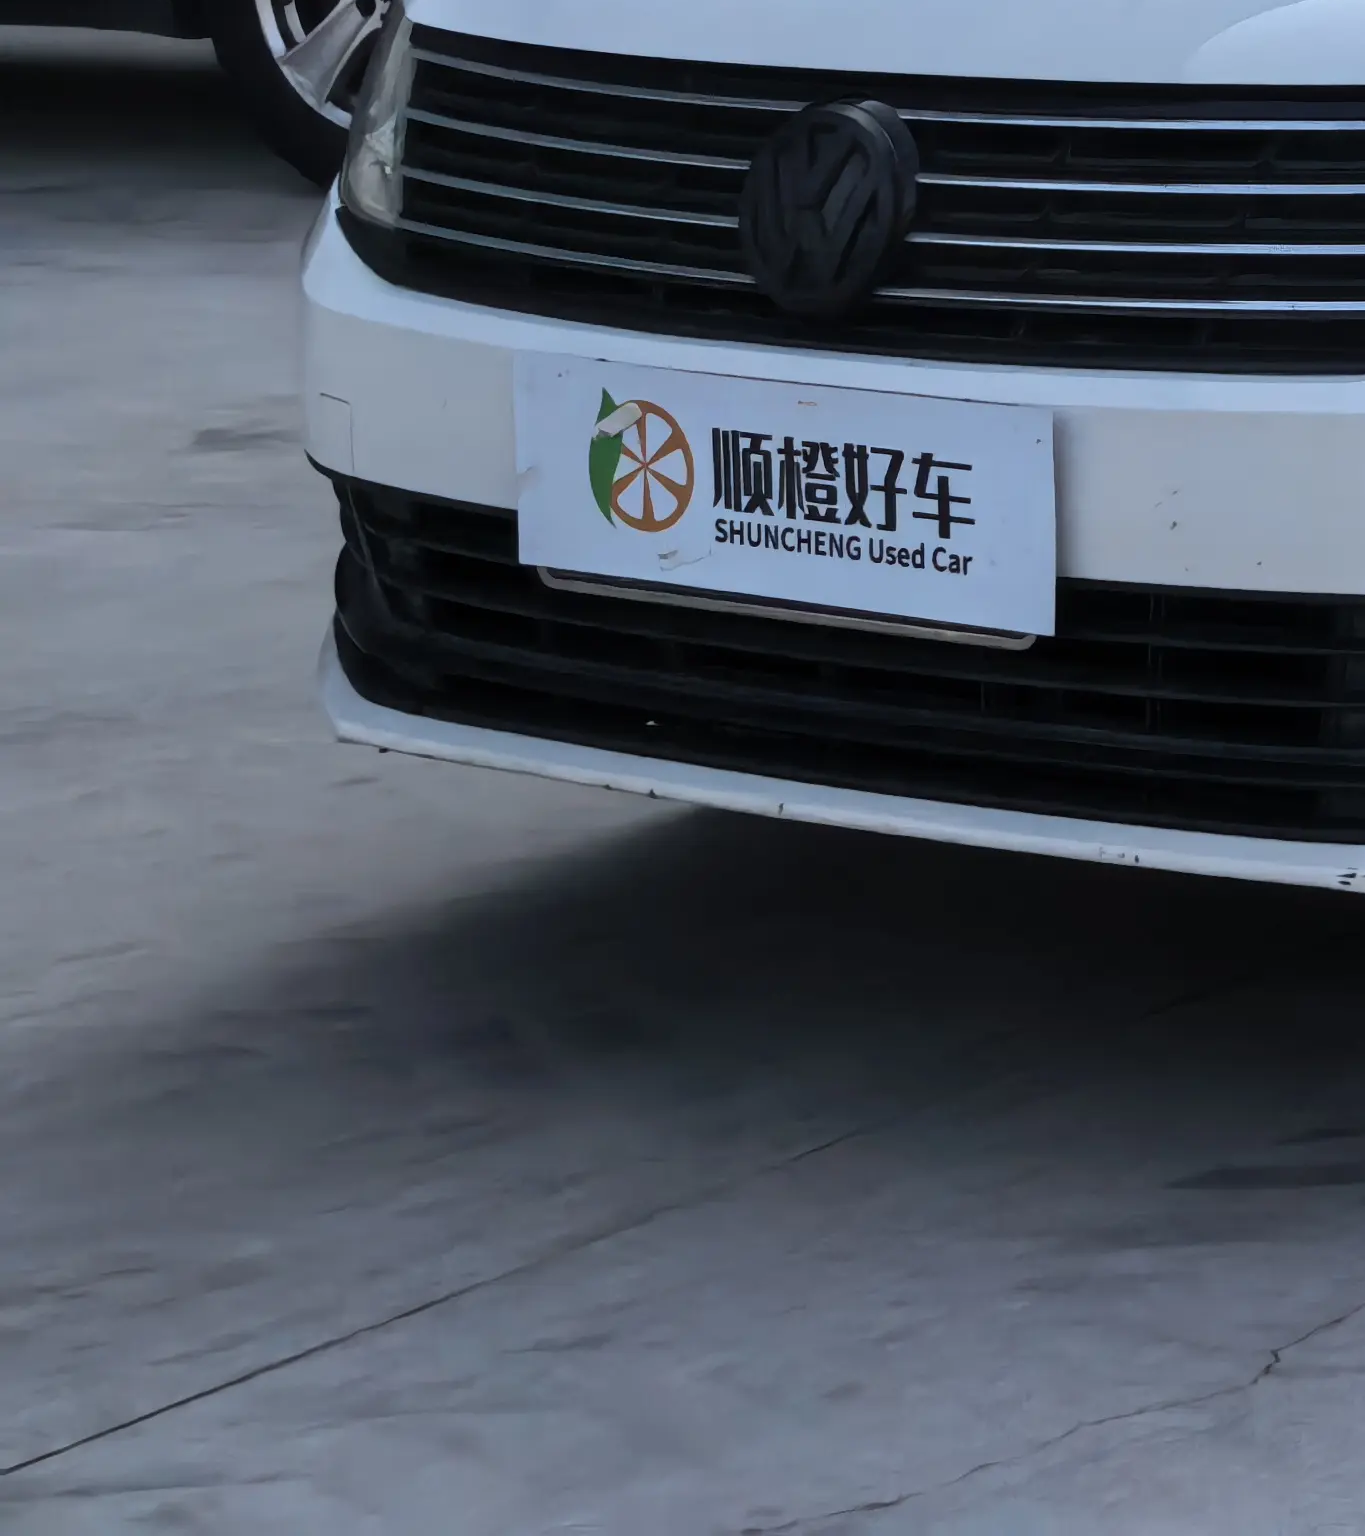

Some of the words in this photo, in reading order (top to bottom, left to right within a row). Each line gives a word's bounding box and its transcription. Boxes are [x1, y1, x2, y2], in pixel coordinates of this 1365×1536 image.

[711, 427, 976, 539] 顺橙好车
[714, 518, 862, 560] SHUNCHENG
[868, 537, 925, 570] Used
[931, 546, 974, 576] Car
